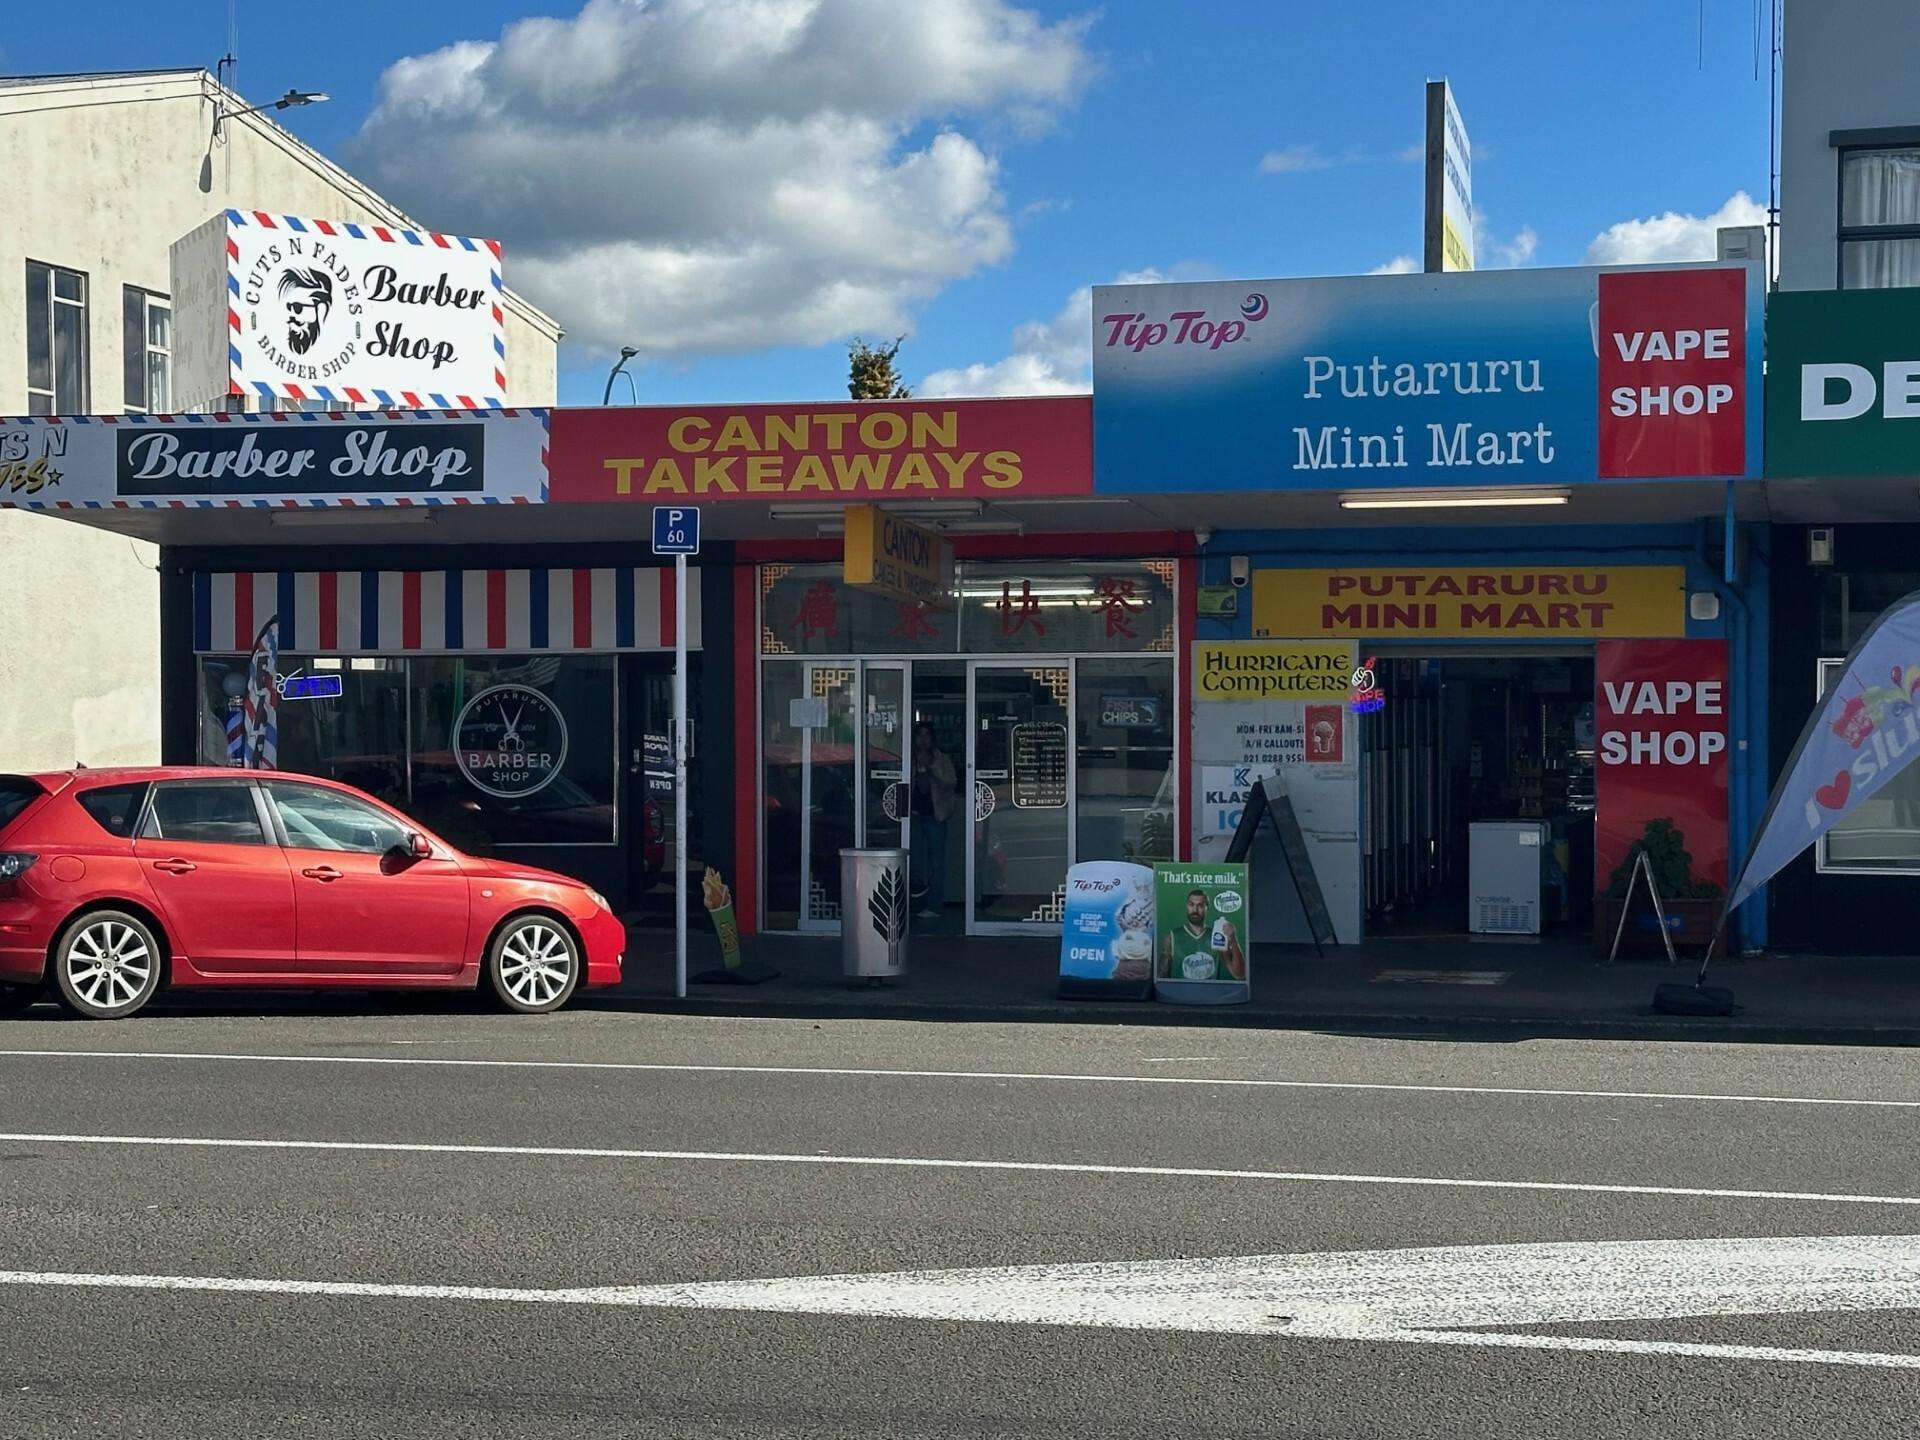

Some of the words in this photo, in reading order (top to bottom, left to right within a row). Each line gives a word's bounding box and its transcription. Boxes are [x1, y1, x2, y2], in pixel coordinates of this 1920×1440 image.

[246, 245, 281, 305] CUTS
[289, 237, 303, 256] N
[312, 241, 362, 315] FADES
[363, 264, 486, 310] Barber
[365, 320, 459, 370] Shop
[1102, 312, 1168, 352] Tip
[1170, 311, 1246, 350] Top
[1612, 329, 1731, 363] VAPE
[258, 335, 318, 380] BARBER
[322, 341, 357, 378] SHOP
[1303, 355, 1544, 400] Putaruru
[1801, 361, 1920, 421] DE
[1609, 384, 1735, 418] SHOP
[41, 426, 68, 458] N
[667, 411, 958, 452] CANTON
[1292, 424, 1408, 471] Mini
[1426, 422, 1555, 468] Mart
[126, 432, 317, 480] Barber
[329, 430, 474, 487] Shop
[604, 451, 1024, 495] TAKEAWAYS
[669, 510, 684, 527] P
[667, 529, 684, 543] 60
[1327, 573, 1608, 598] PUTARURU
[1321, 603, 1438, 629] MINI
[1460, 602, 1614, 628] MART
[1601, 681, 1723, 716] VAPE
[1102, 711, 1139, 724] CHIPS
[469, 753, 552, 769] BARBER
[1600, 731, 1726, 765] SHOP
[492, 771, 530, 782] SHOP
[1206, 791, 1254, 804] KLAS
[1073, 879, 1092, 891] Tip
[1093, 880, 1114, 893] Top
[1193, 872, 1213, 885] nice
[1070, 947, 1105, 962] OPEN
